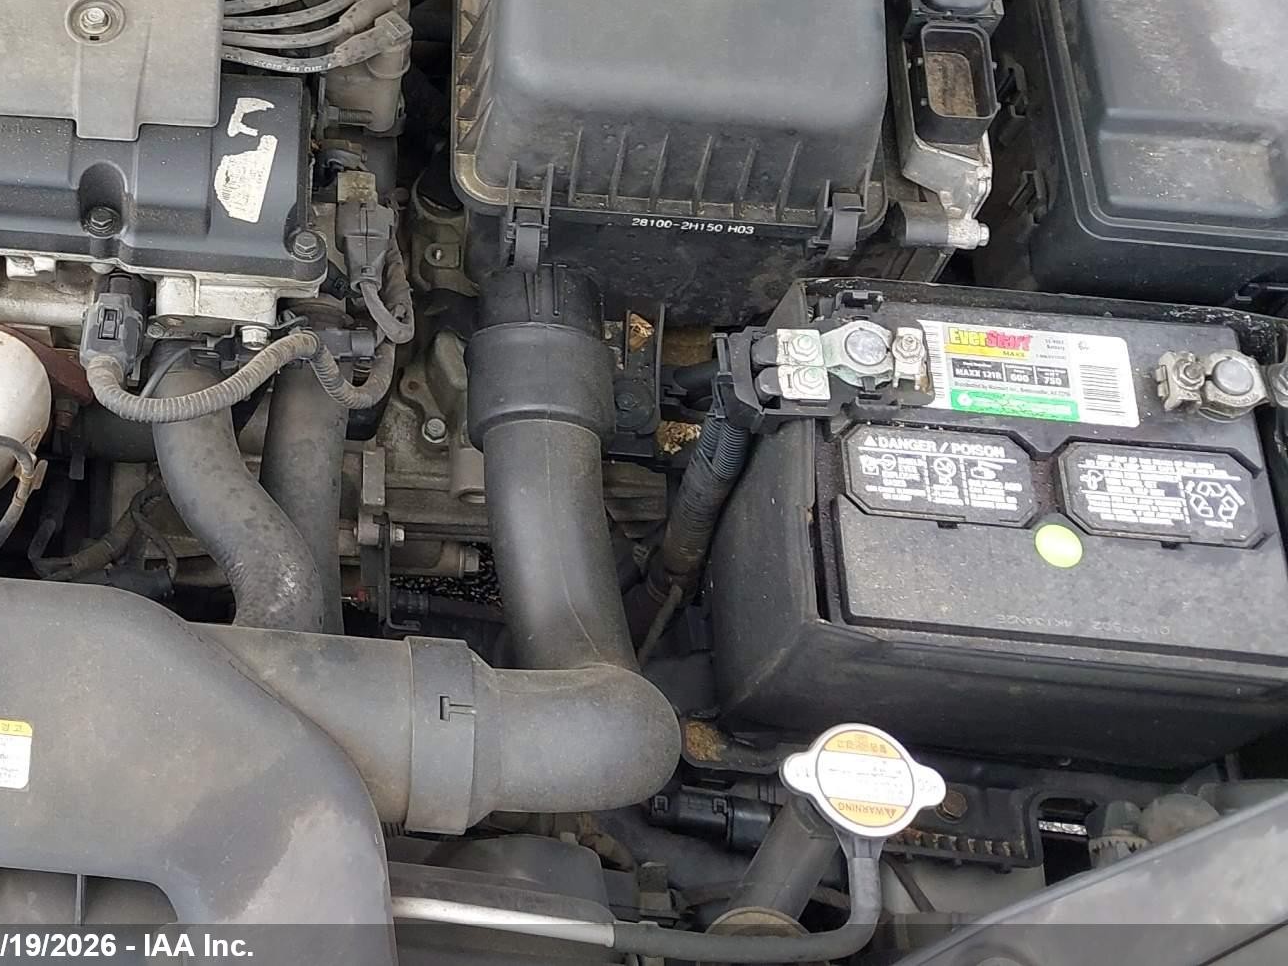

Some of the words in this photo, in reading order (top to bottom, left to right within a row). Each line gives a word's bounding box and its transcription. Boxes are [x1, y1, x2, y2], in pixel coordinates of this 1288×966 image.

[631, 217, 724, 232] 28100-2H150
[727, 225, 755, 234] H03
[948, 326, 1032, 351] EverStart
[877, 436, 937, 453] DANGER
[951, 443, 1005, 458] POISON
[838, 801, 886, 817] WARNING
